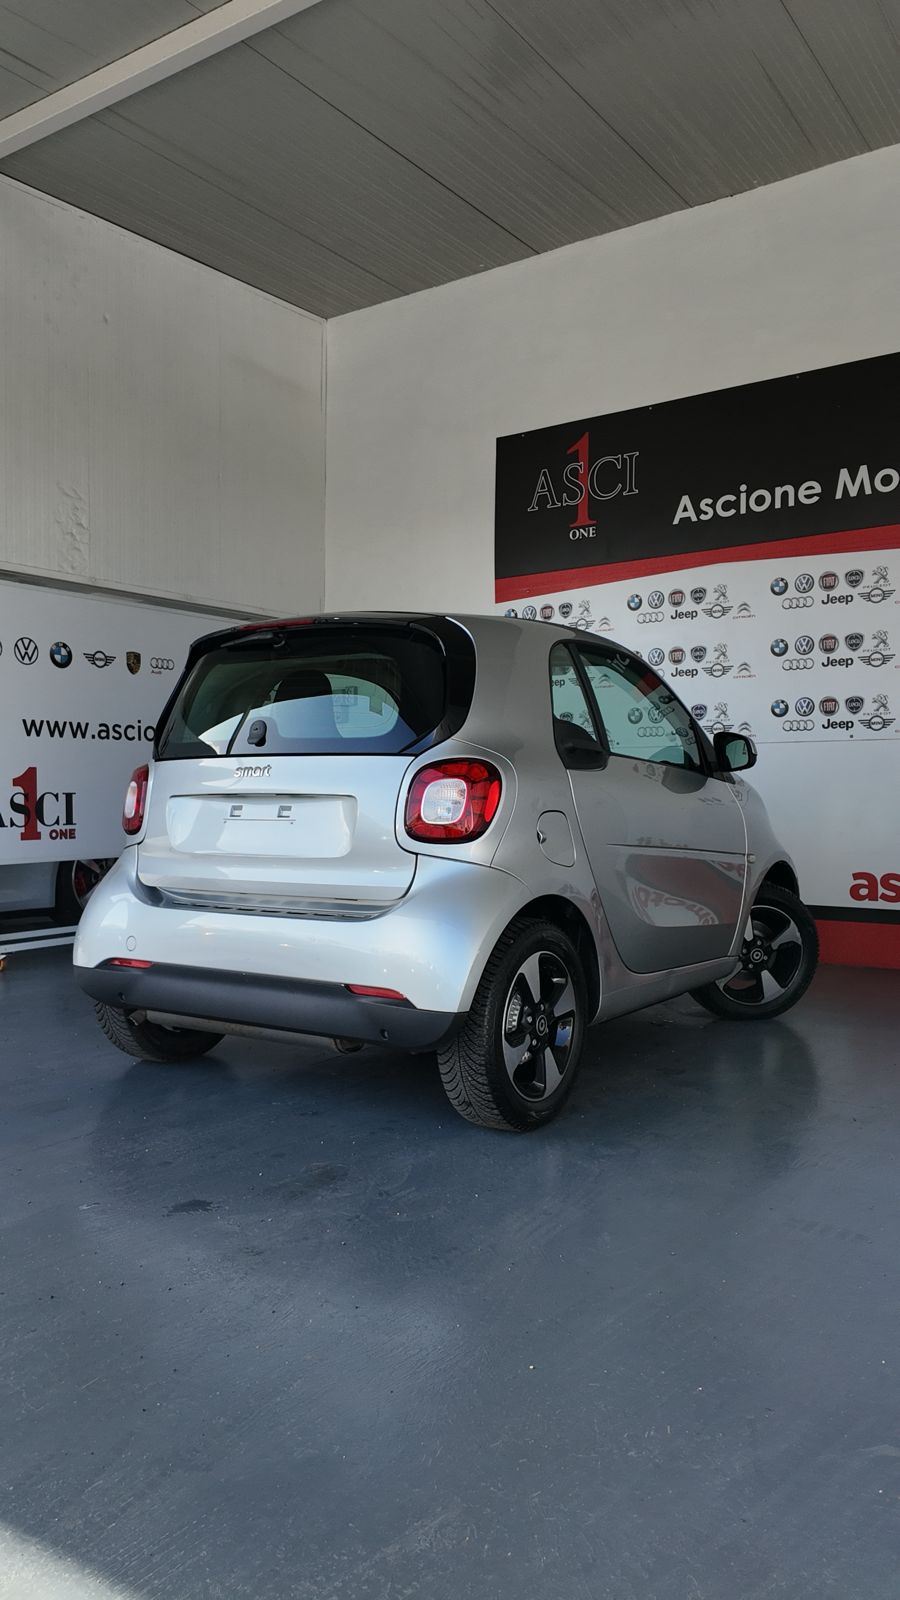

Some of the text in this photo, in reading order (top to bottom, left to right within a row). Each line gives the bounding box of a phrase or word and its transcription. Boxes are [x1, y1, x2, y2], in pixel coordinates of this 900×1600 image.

[527, 452, 639, 512] ASCI
[672, 464, 900, 526] Ascione Mo
[569, 526, 597, 541] ONE
[821, 593, 854, 606] Jeep
[670, 609, 699, 620] Jeep
[821, 656, 854, 668] Jeep
[671, 667, 699, 678] Jeep
[22, 719, 156, 742] www.ascio
[821, 718, 855, 731] Jeep
[234, 764, 272, 778] smart
[49, 828, 76, 841] ONE
[850, 872, 900, 903] as
